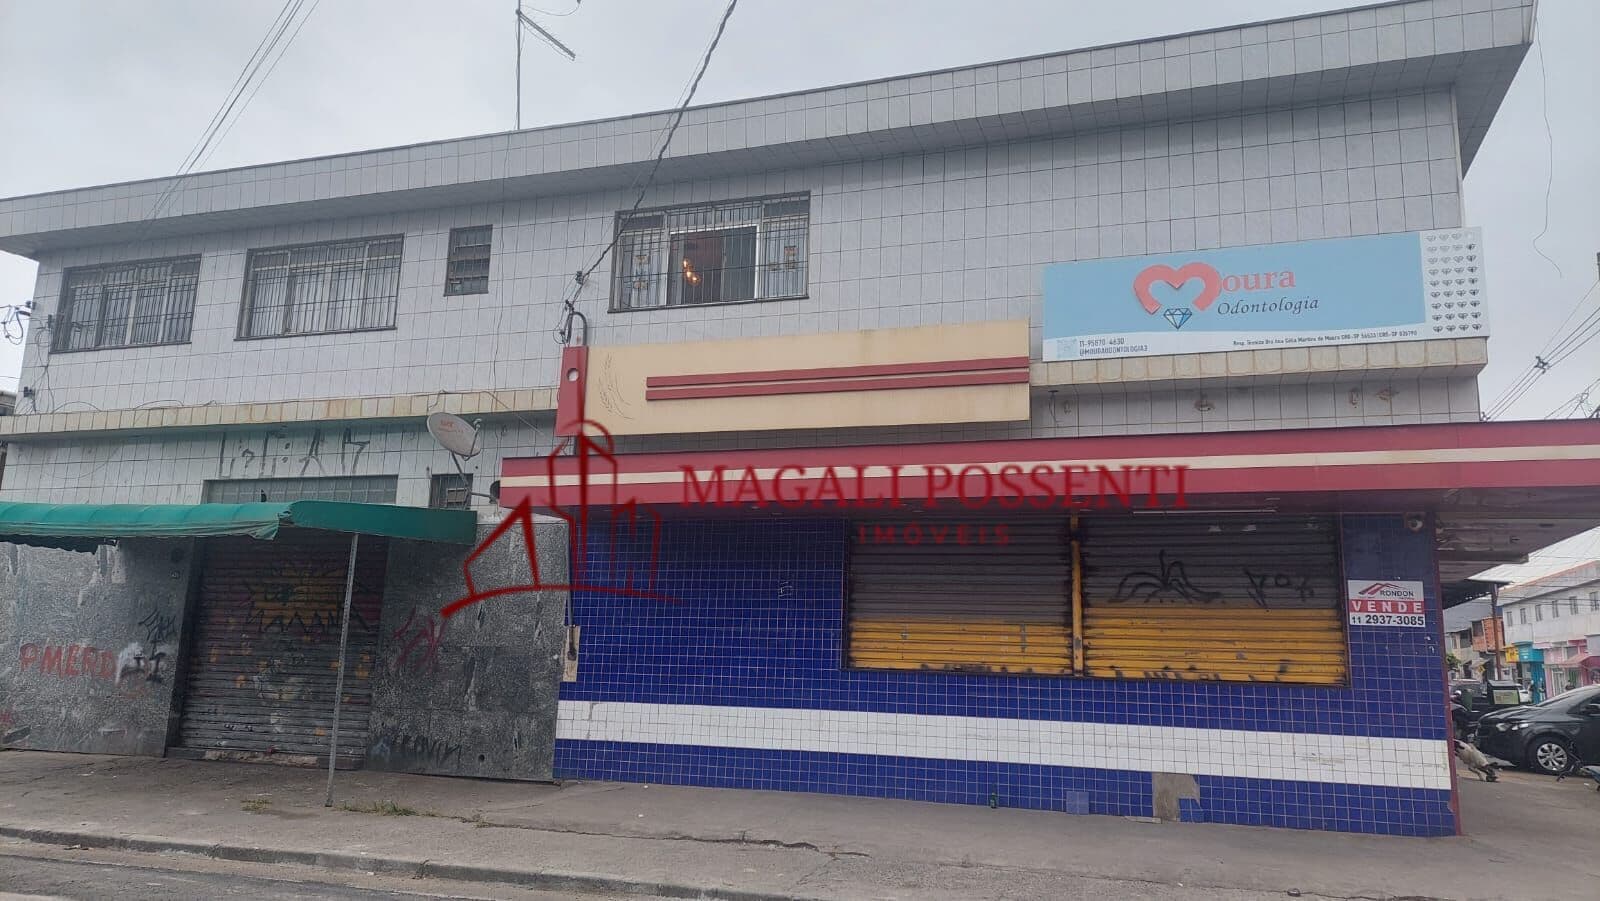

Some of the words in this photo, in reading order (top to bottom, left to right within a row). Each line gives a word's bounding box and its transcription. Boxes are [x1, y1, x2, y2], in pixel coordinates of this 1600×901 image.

[1217, 296, 1320, 317] Odontologia
[1351, 600, 1422, 613] VENDE
[1366, 614, 1424, 626] 2937-3085
